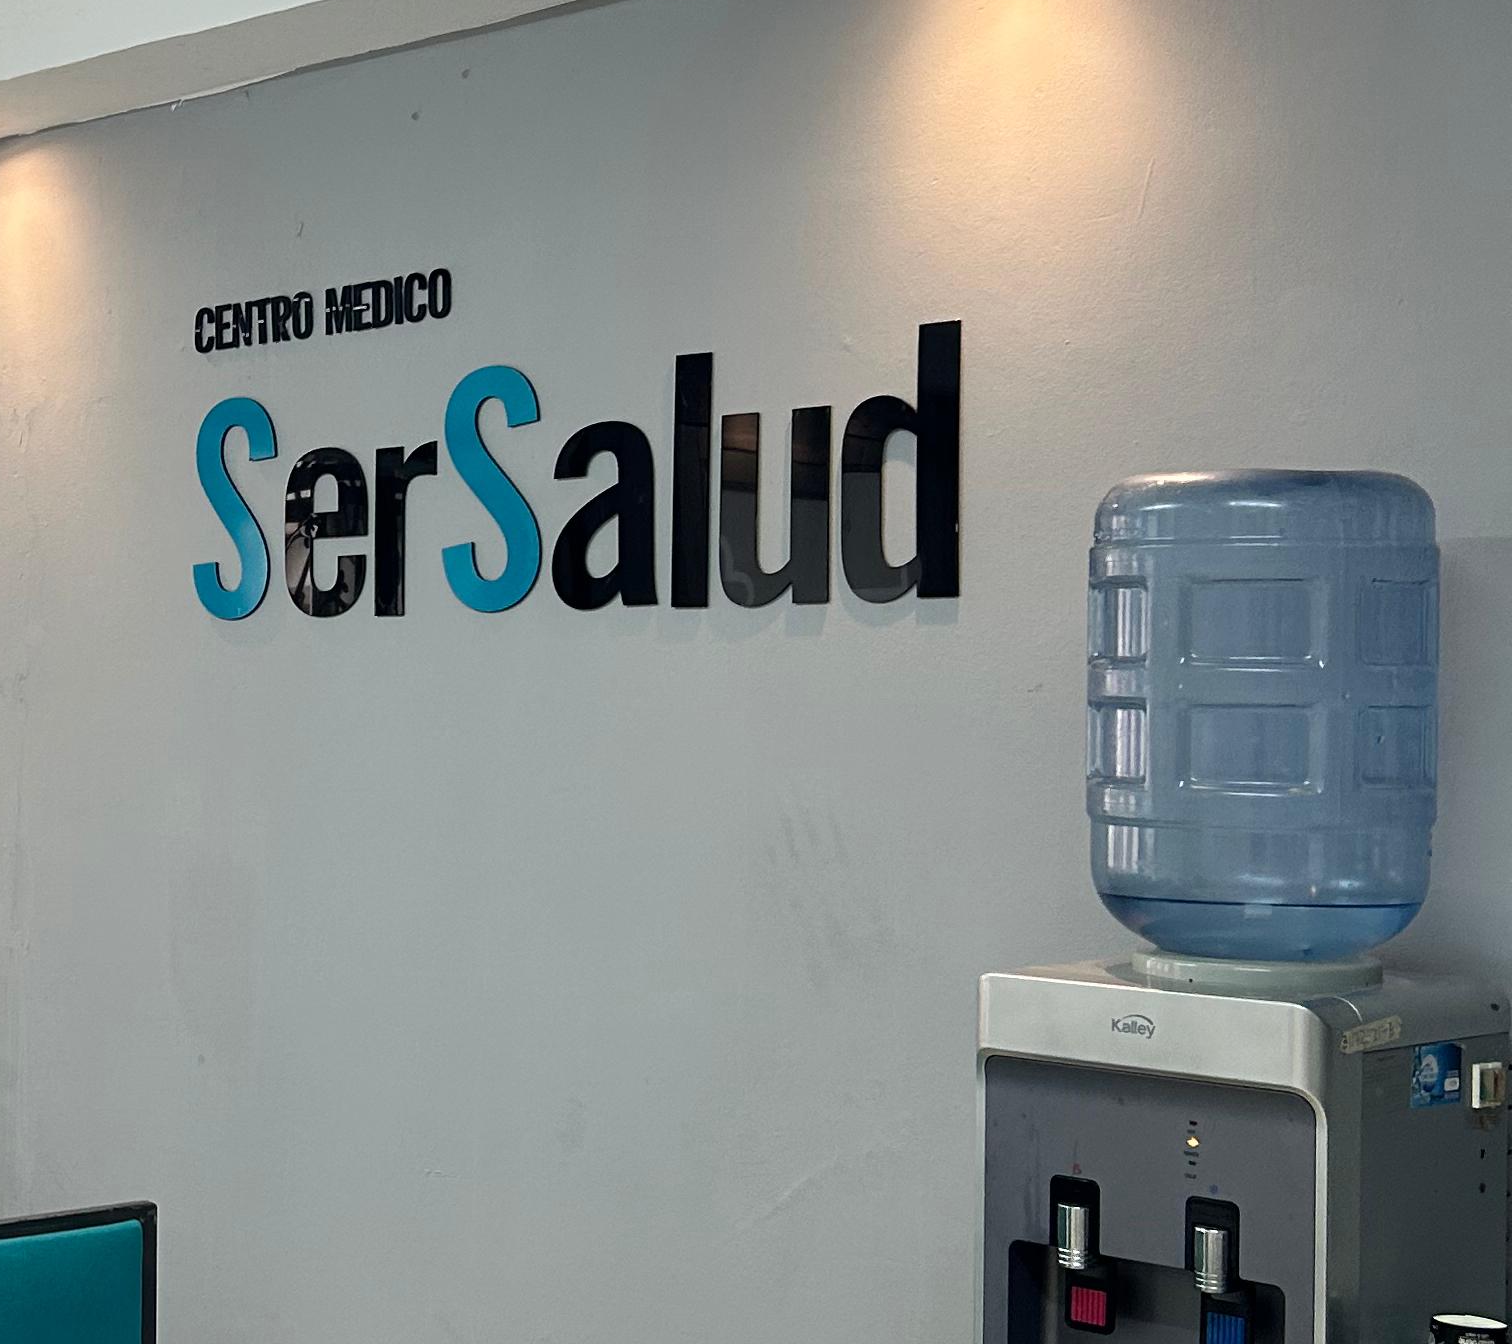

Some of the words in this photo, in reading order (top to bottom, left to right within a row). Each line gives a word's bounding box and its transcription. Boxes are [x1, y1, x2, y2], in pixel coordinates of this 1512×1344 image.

[194, 291, 314, 353] CENTRO
[325, 268, 452, 335] MEDICO
[192, 319, 962, 620] SerSalud
[1111, 1017, 1156, 1040] Kalley
